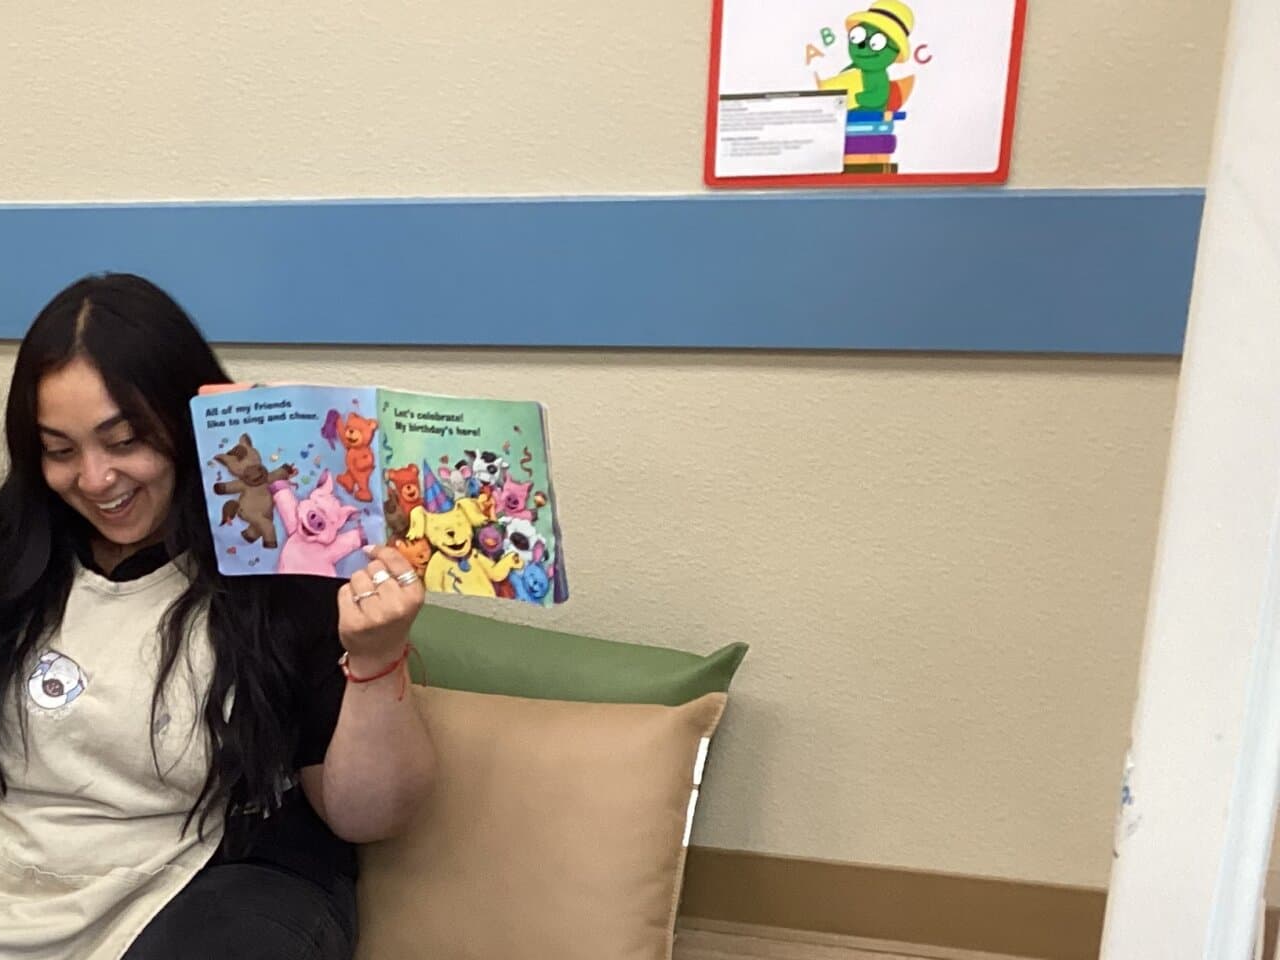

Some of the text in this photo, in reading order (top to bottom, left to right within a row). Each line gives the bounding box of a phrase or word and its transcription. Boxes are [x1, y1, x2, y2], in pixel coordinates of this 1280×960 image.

[805, 26, 933, 65] A B C
[205, 399, 292, 417] All of my friends
[394, 407, 464, 422] Let's celebrate!
[207, 419, 226, 429] like
[228, 418, 240, 426] to
[243, 415, 265, 425] sing
[267, 412, 287, 422] and
[395, 421, 481, 437] My birthday's here!
